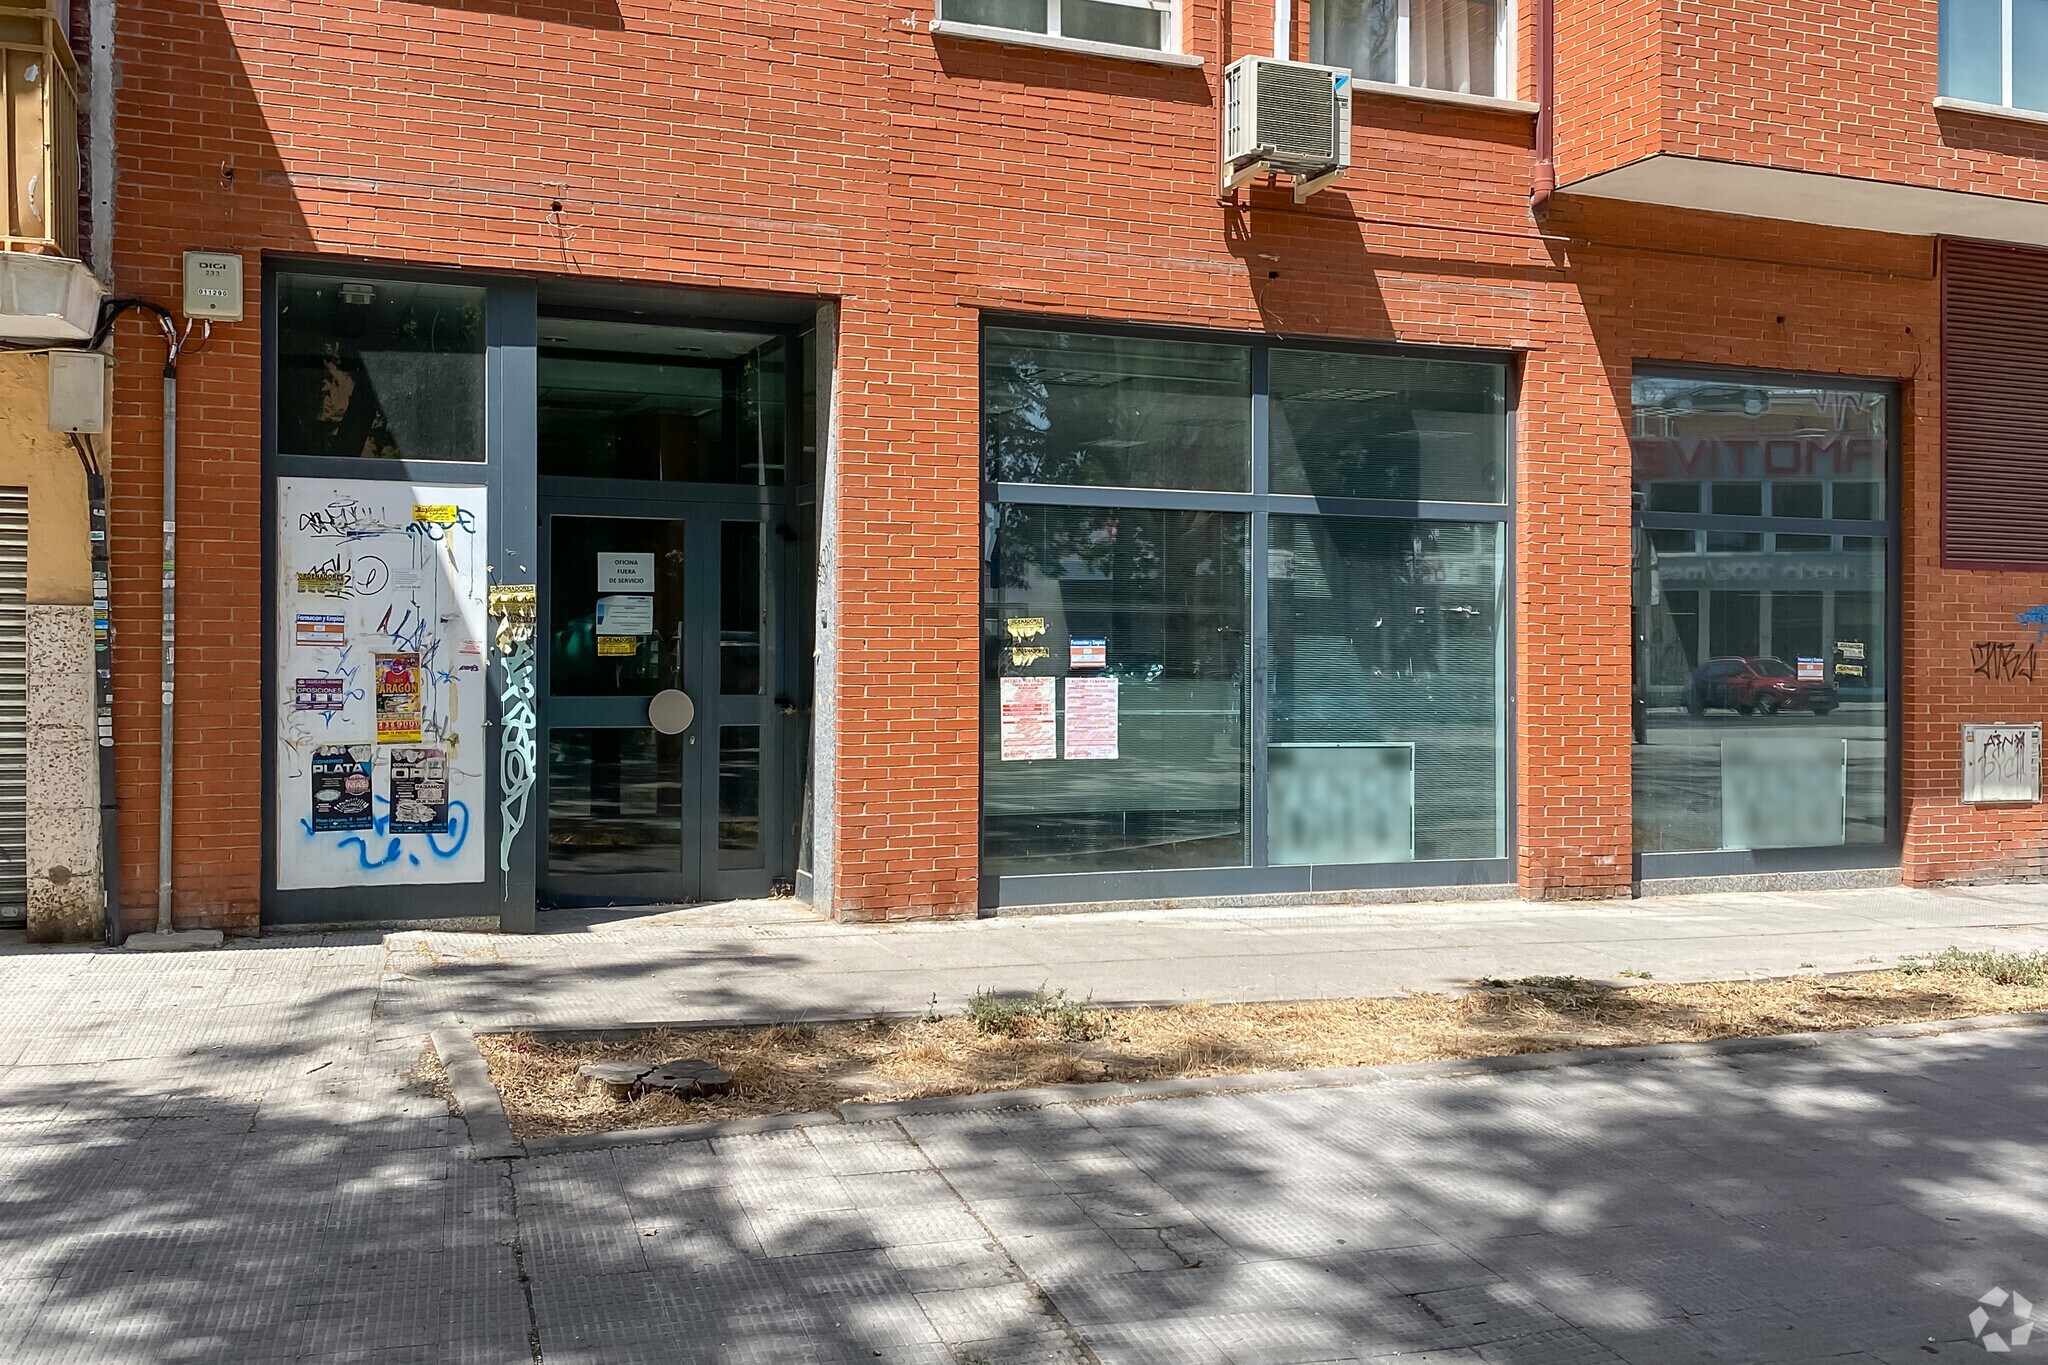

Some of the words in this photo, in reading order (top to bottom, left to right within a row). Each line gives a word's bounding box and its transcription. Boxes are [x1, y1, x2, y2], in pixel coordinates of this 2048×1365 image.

[199, 262, 227, 270] DIGI
[198, 288, 228, 297] 011290
[379, 681, 418, 694] ARAGÓN
[312, 763, 364, 774] PLATA
